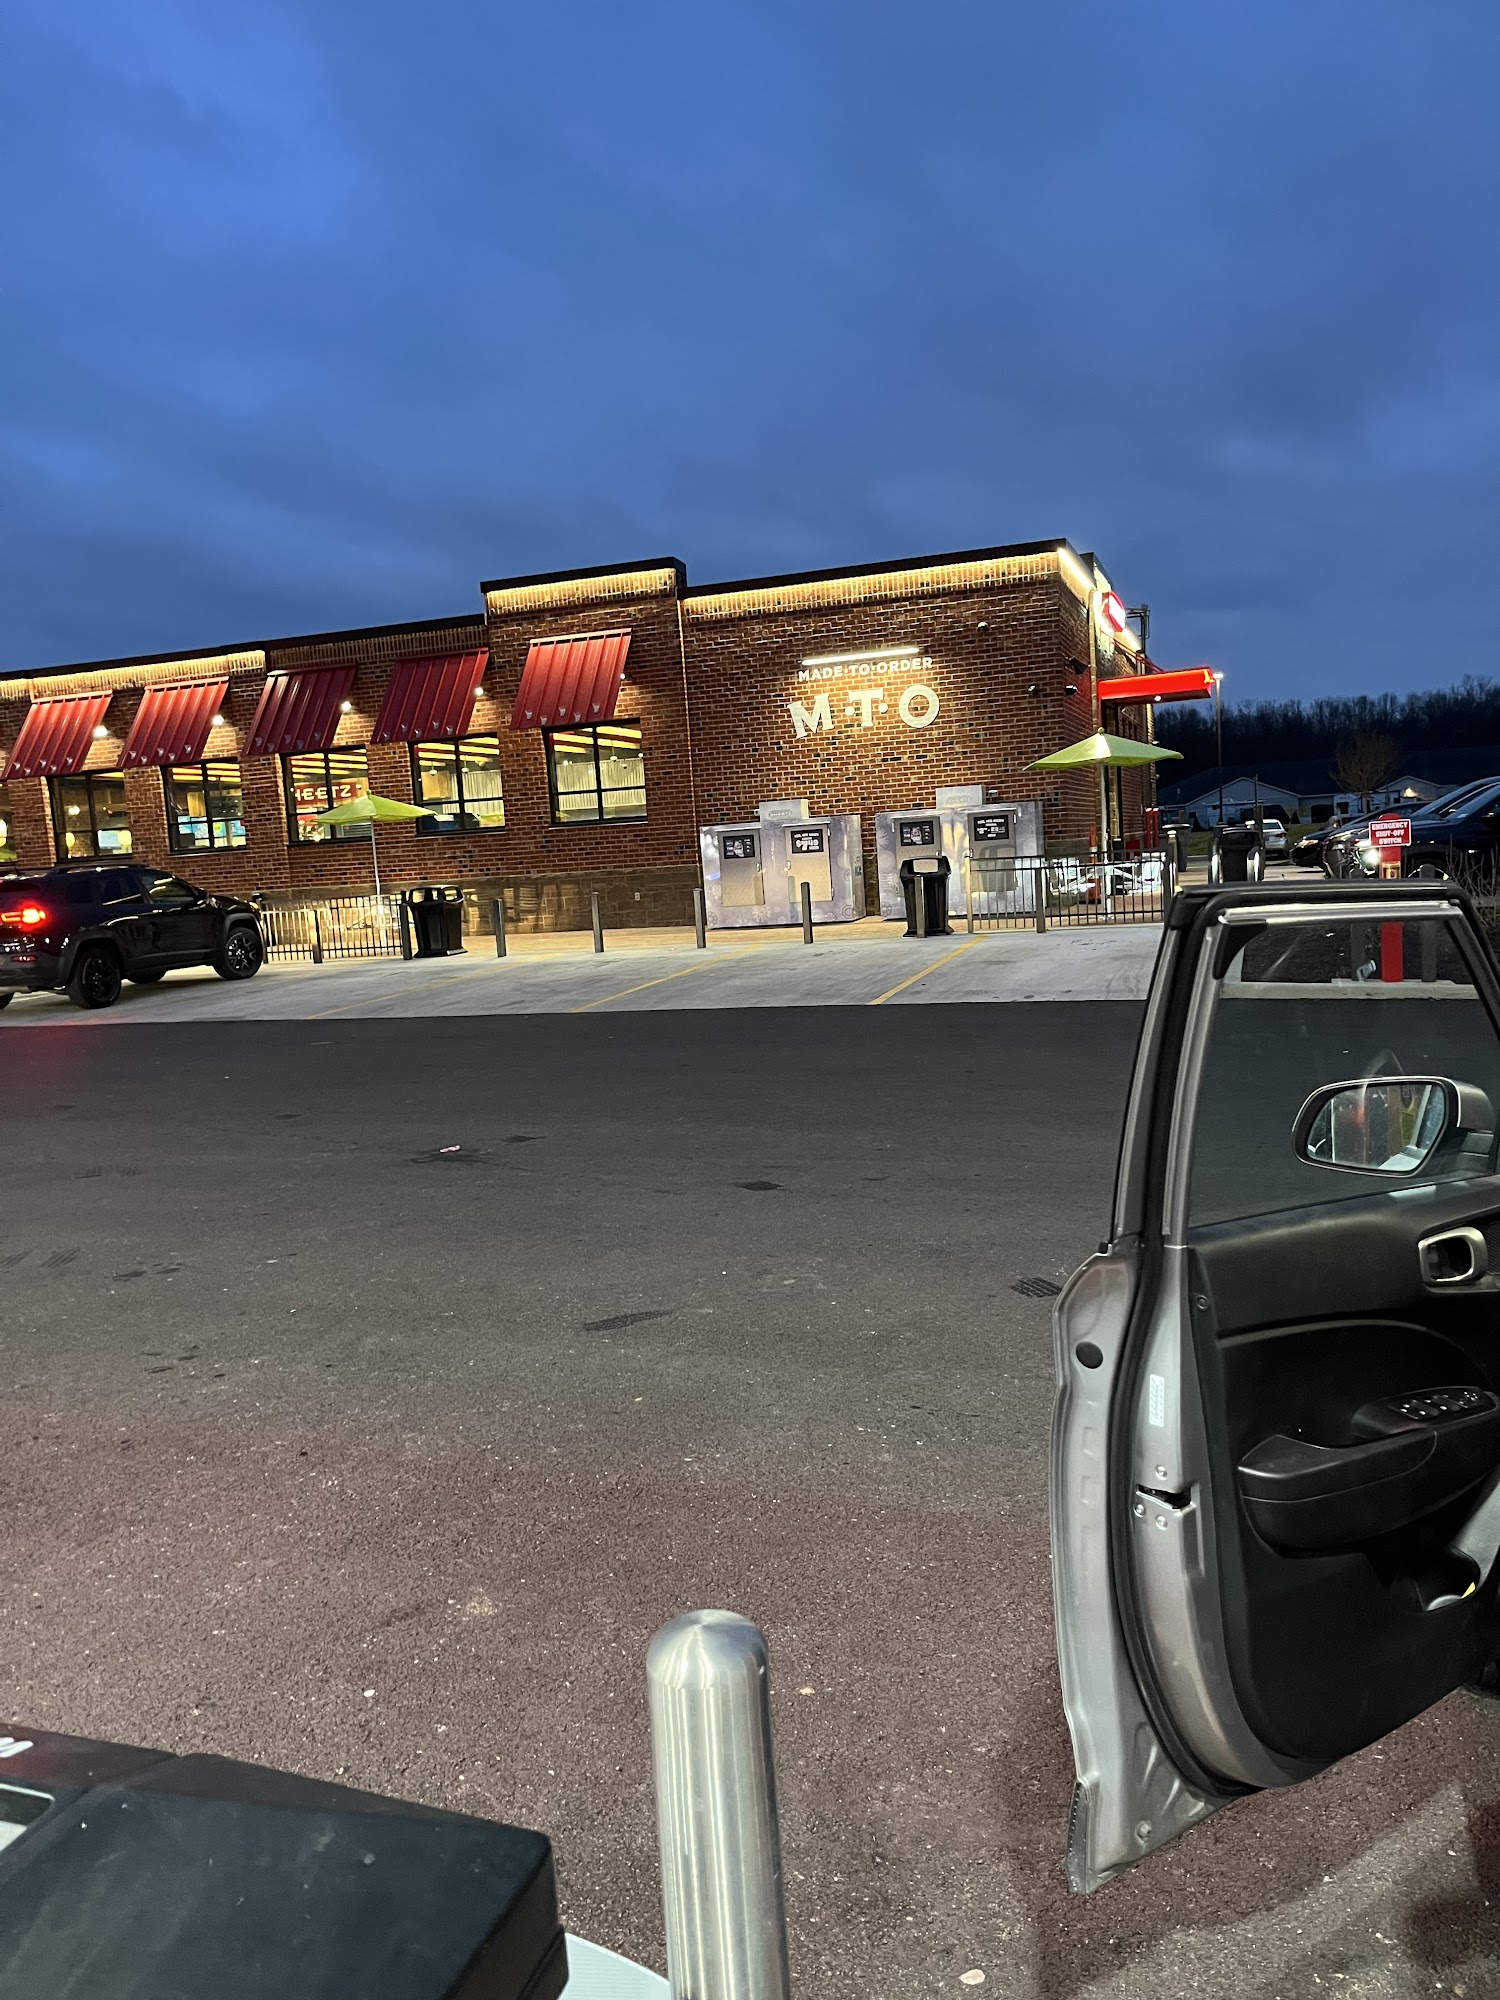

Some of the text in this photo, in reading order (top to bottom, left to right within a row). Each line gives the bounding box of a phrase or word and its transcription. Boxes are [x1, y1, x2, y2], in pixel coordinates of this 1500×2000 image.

[1371, 822, 1408, 830] EMERGENCY
[1375, 829, 1405, 838] SHUT-OFF
[1378, 837, 1402, 845] SWITCH
